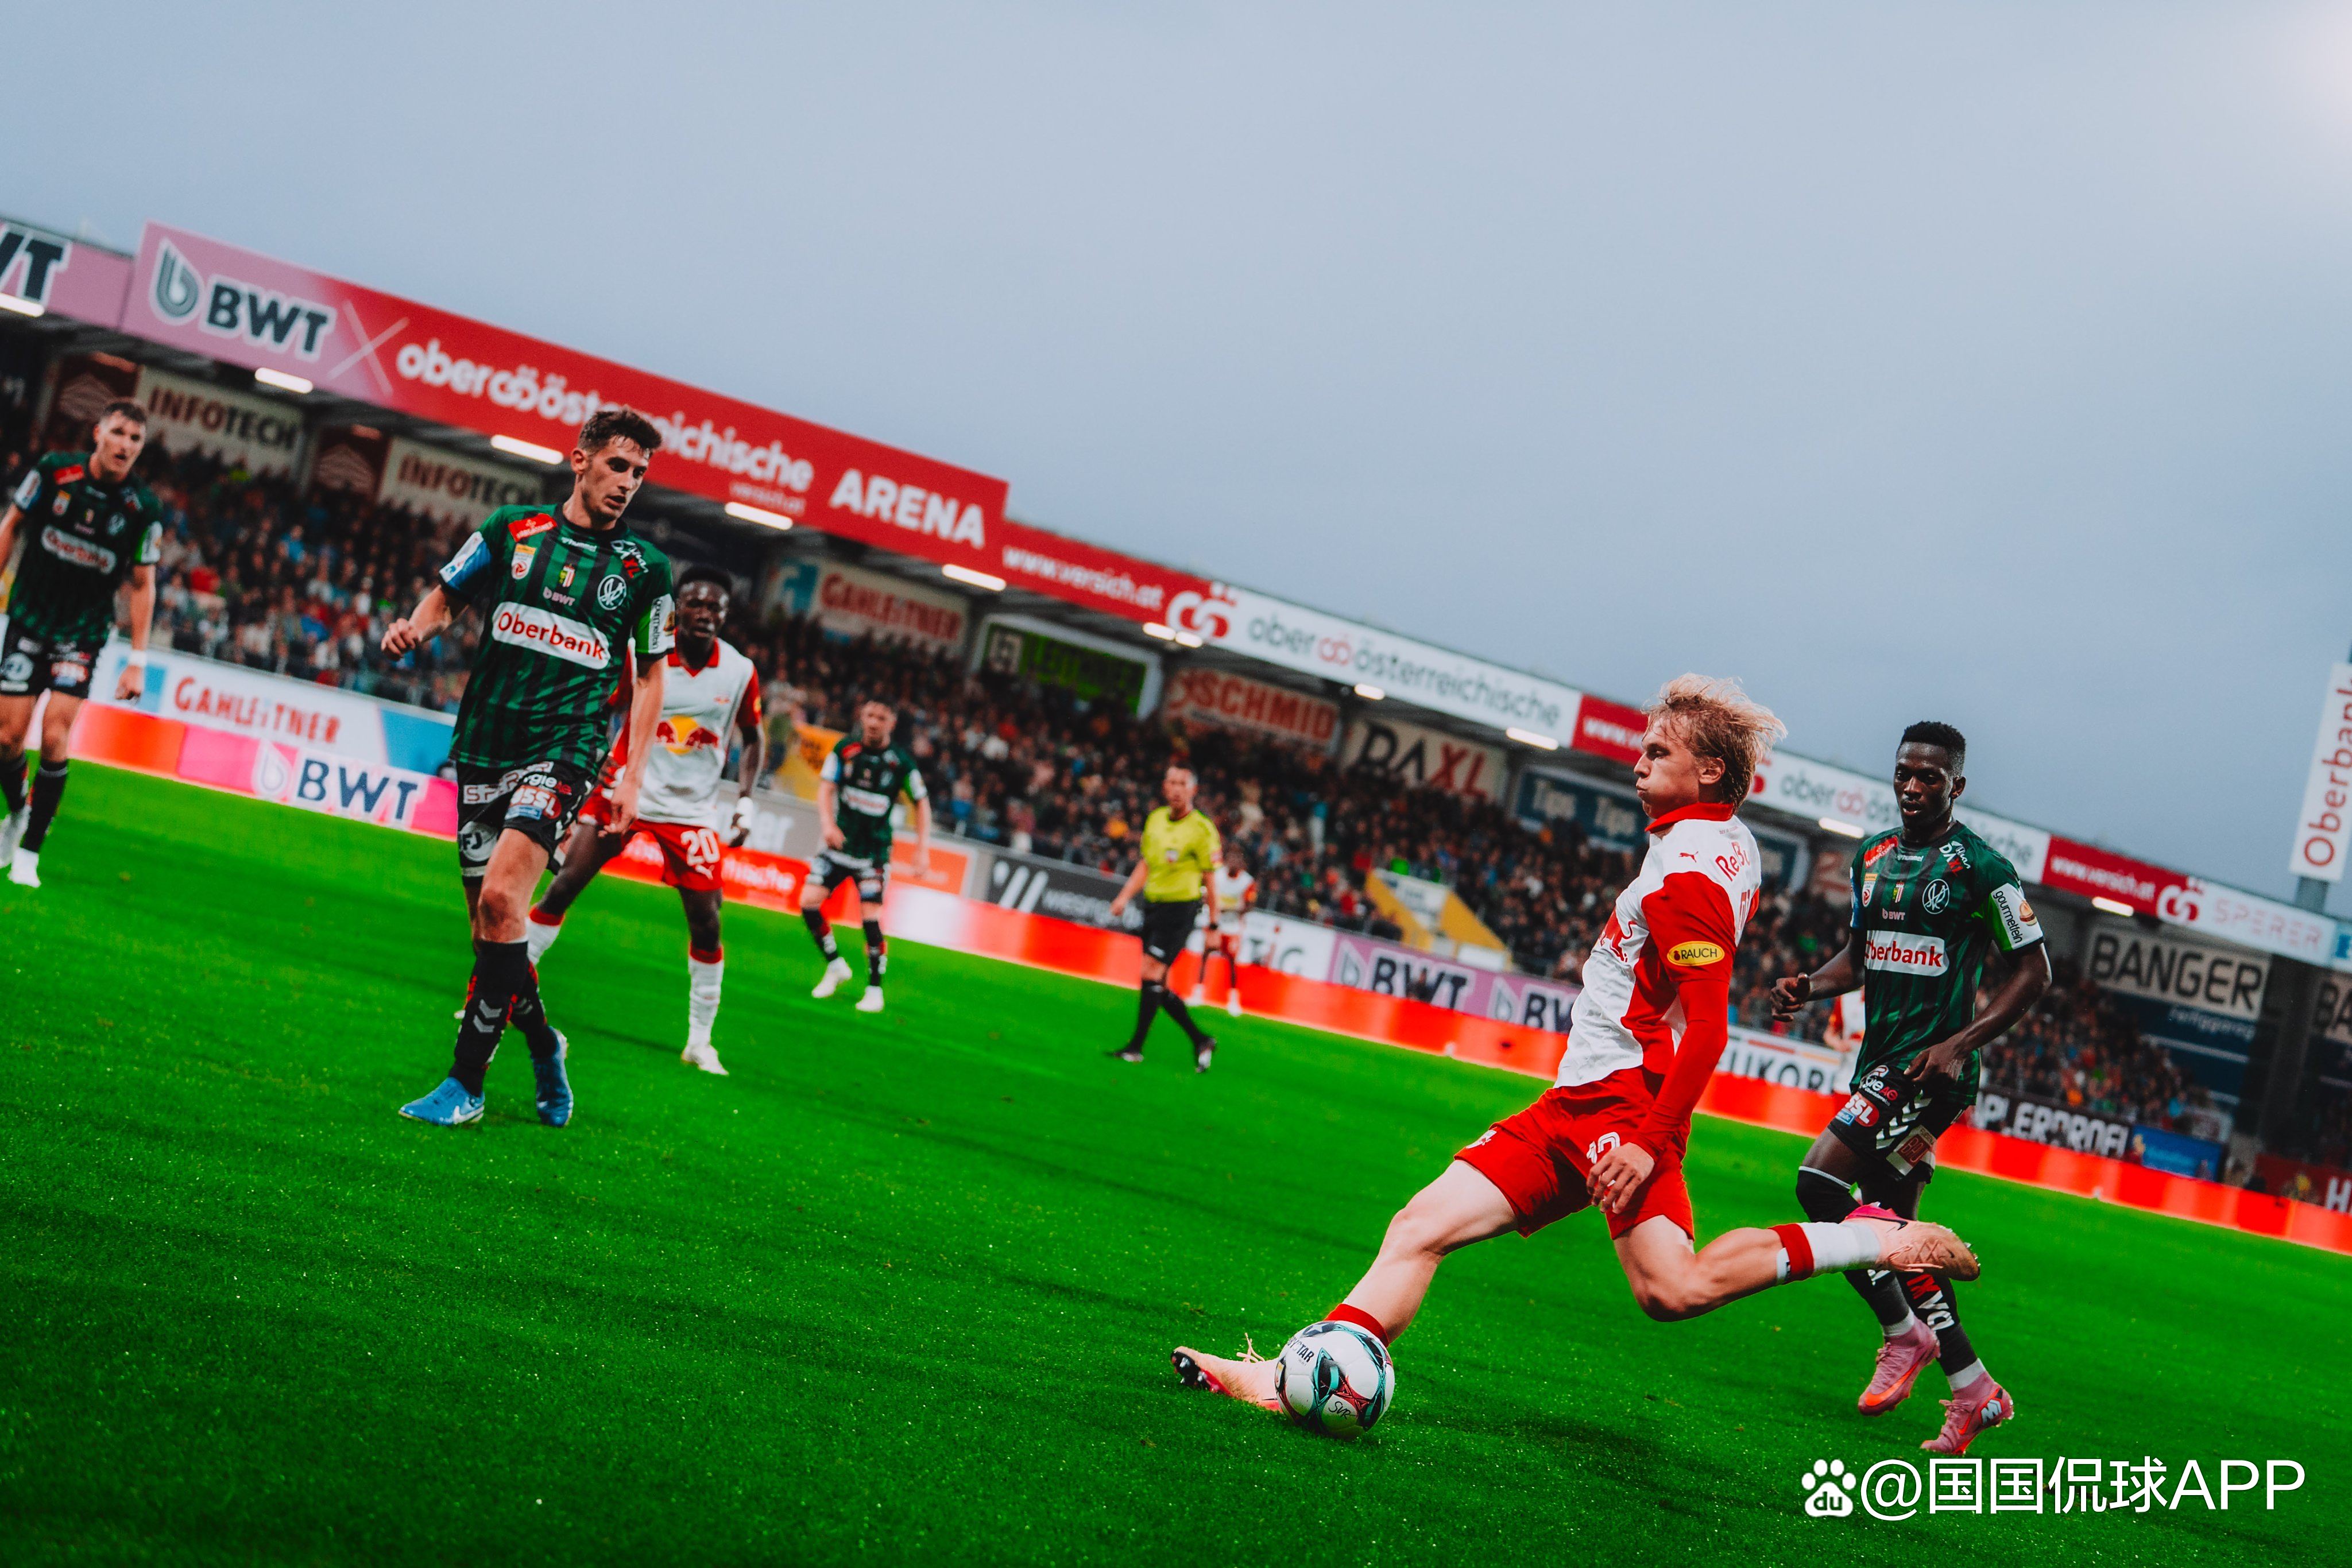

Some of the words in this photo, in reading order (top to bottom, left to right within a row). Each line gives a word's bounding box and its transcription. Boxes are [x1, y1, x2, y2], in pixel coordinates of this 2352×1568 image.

[206, 282, 329, 354] BWT
[829, 468, 985, 549] ARENA
[1003, 544, 1165, 610] www.versich.at
[498, 611, 605, 660] Oberbank
[297, 758, 418, 820] BWT
[680, 828, 720, 867] 20
[1889, 911, 1905, 920] BWT
[1993, 891, 2023, 943] gourmetfein
[1681, 948, 1717, 960] RAUCH
[2090, 932, 2262, 1012] BANGER
[1372, 957, 1467, 1011] BWT
[1328, 1401, 1353, 1420] SVR
